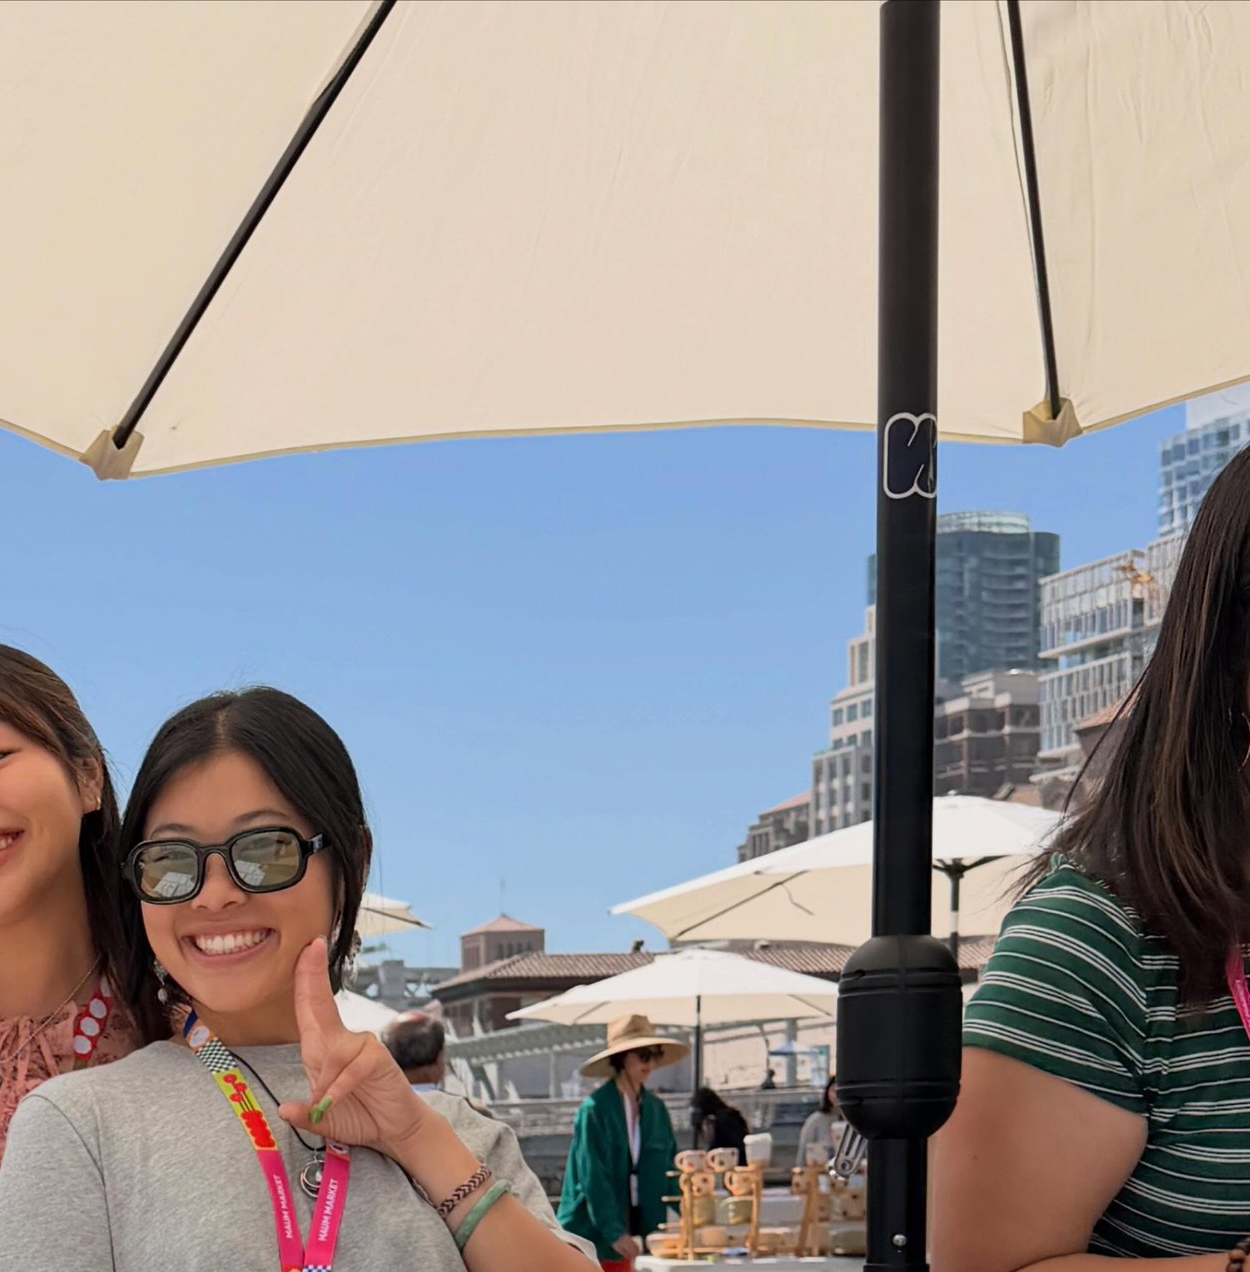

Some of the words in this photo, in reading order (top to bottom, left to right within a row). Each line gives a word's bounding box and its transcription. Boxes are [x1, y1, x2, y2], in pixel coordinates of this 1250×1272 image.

[273, 1174, 288, 1211] MARKET
[323, 1178, 339, 1216] MARKET
[317, 1215, 332, 1241] MAUM
